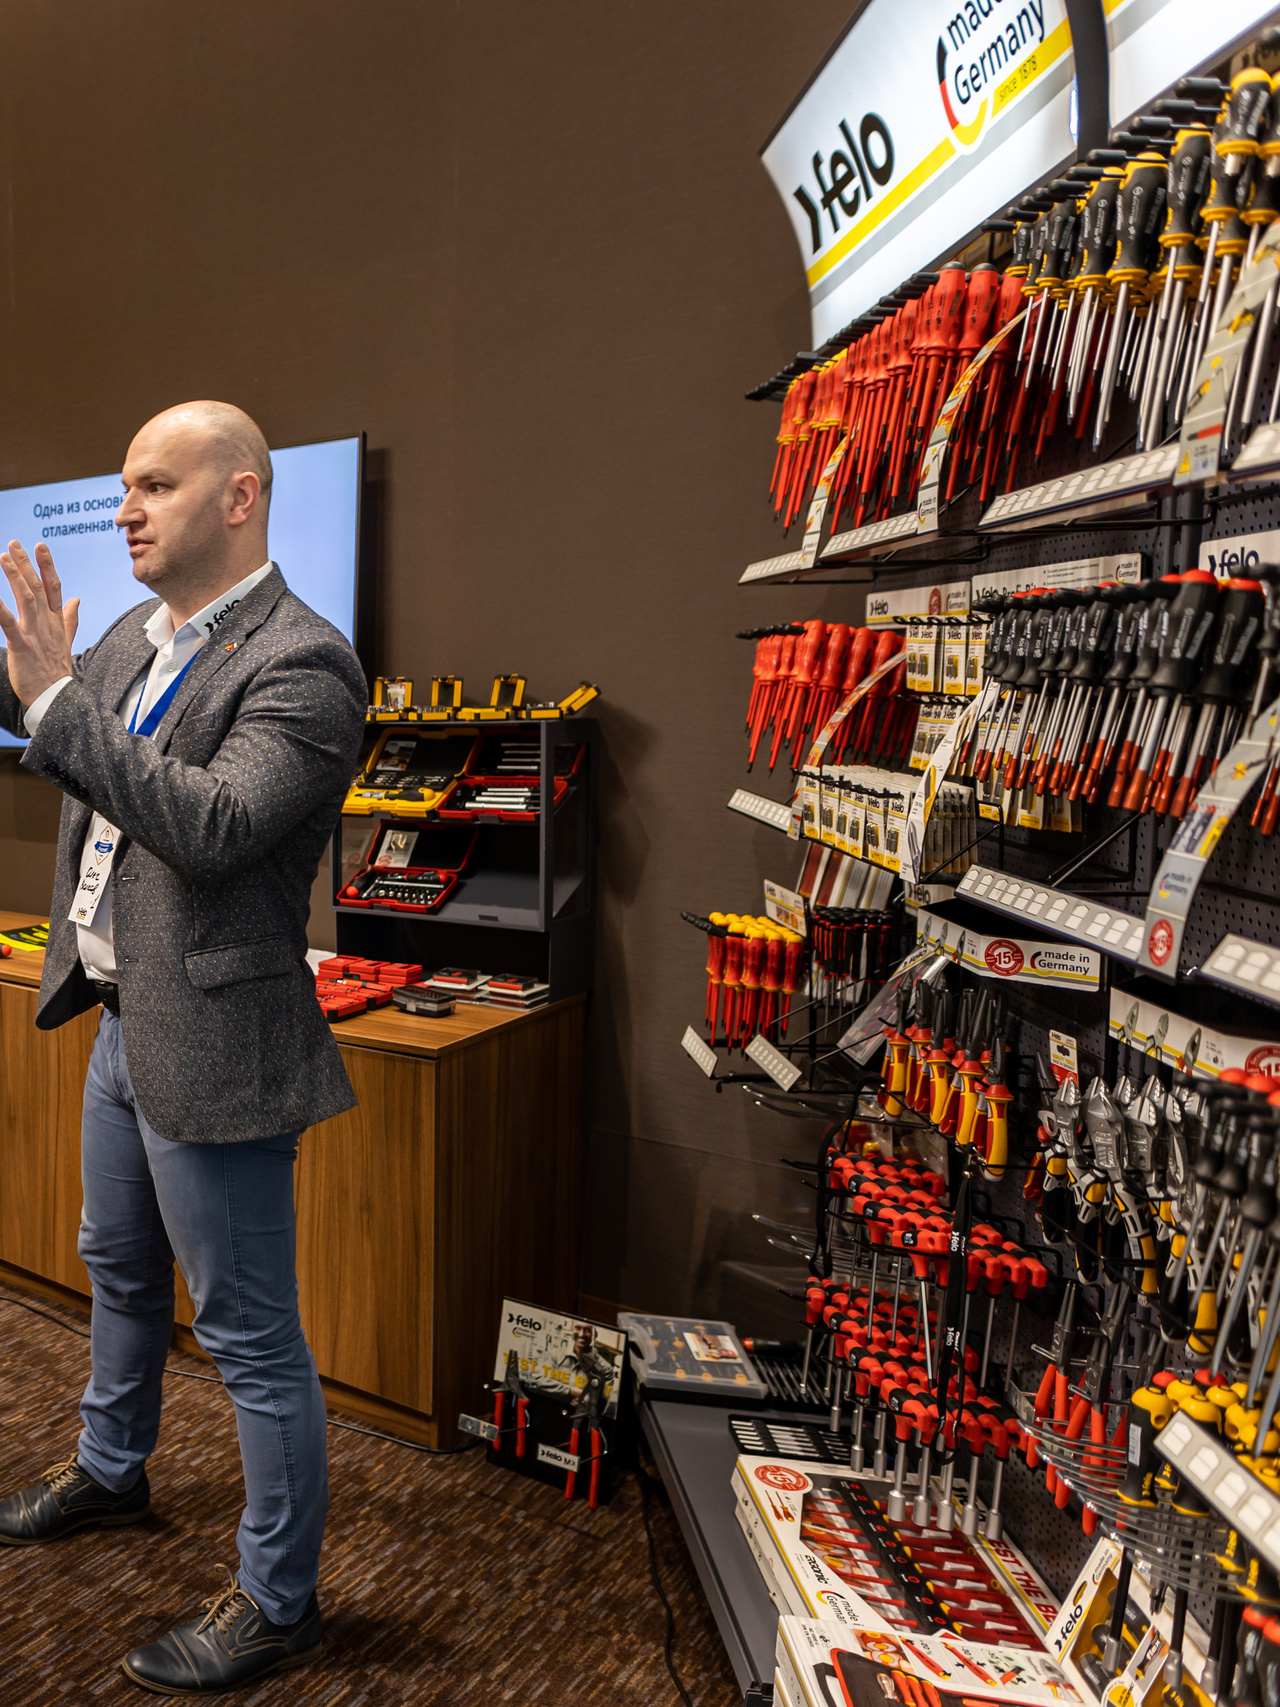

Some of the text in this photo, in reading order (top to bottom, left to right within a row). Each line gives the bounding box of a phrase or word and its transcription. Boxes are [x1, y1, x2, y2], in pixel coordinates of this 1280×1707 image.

[954, 0, 1045, 105] Germany
[1000, 55, 1038, 102] since 1878
[812, 111, 895, 234] felo
[33, 503, 64, 519] Одна
[67, 501, 80, 513] из
[42, 519, 104, 538] отлаженная
[894, 801, 905, 813] felo
[995, 951, 1012, 965] 15
[1044, 950, 1090, 964] made in
[1038, 959, 1090, 976] Germany
[950, 1236, 959, 1252] felo
[516, 1315, 542, 1331] felo
[946, 1331, 954, 1347] felo
[503, 1352, 614, 1398] TST THE BT
[546, 1451, 563, 1462] felo
[989, 1539, 1023, 1568] EST
[1015, 1570, 1048, 1600] THE
[840, 1597, 859, 1622] made
[1060, 1604, 1083, 1639] felo
